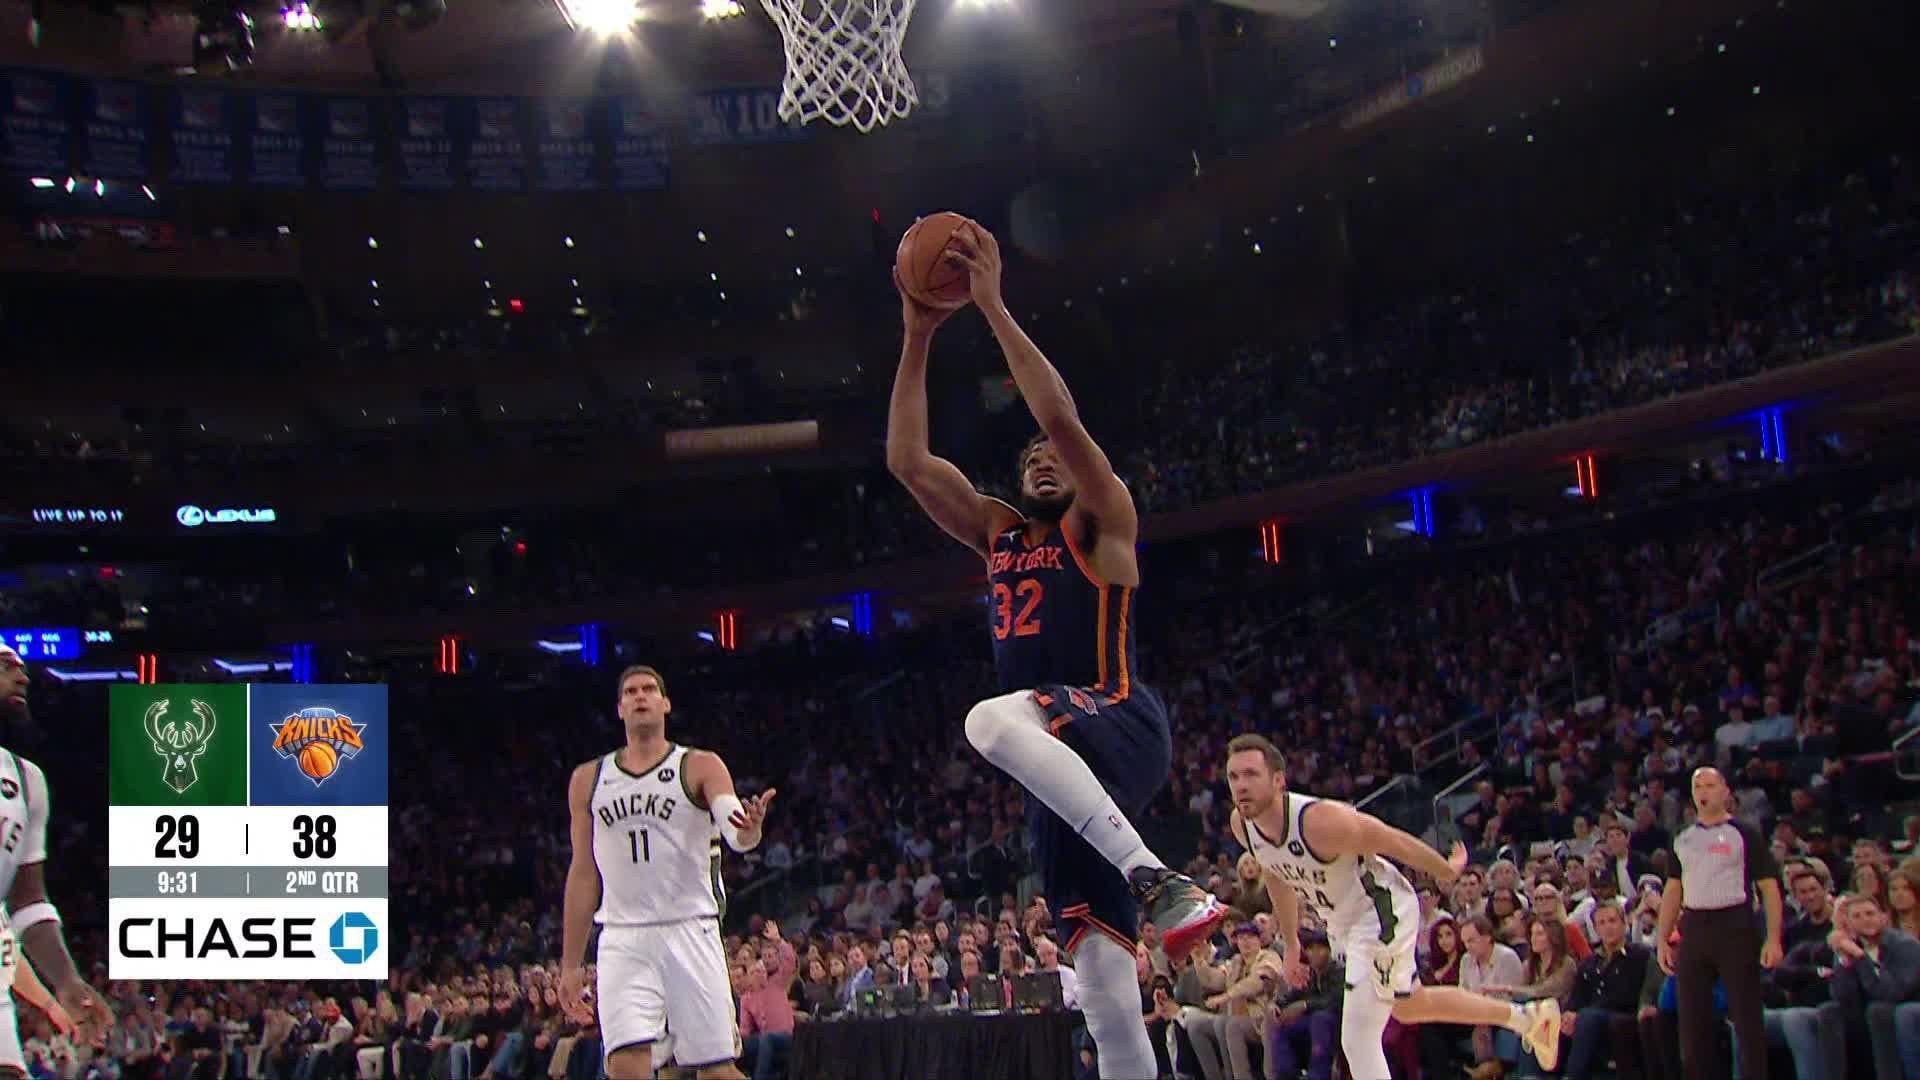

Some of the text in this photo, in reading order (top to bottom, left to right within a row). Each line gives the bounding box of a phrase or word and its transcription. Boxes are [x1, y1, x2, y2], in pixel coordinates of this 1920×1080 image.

[33, 508, 62, 522] LIVE
[67, 508, 86, 522] UP
[90, 509, 108, 522] TO
[205, 509, 276, 522] LEXUS
[1016, 546, 1065, 572] YORK
[993, 578, 1043, 641] 32
[598, 793, 677, 827] BUCKS
[628, 828, 651, 865] 11
